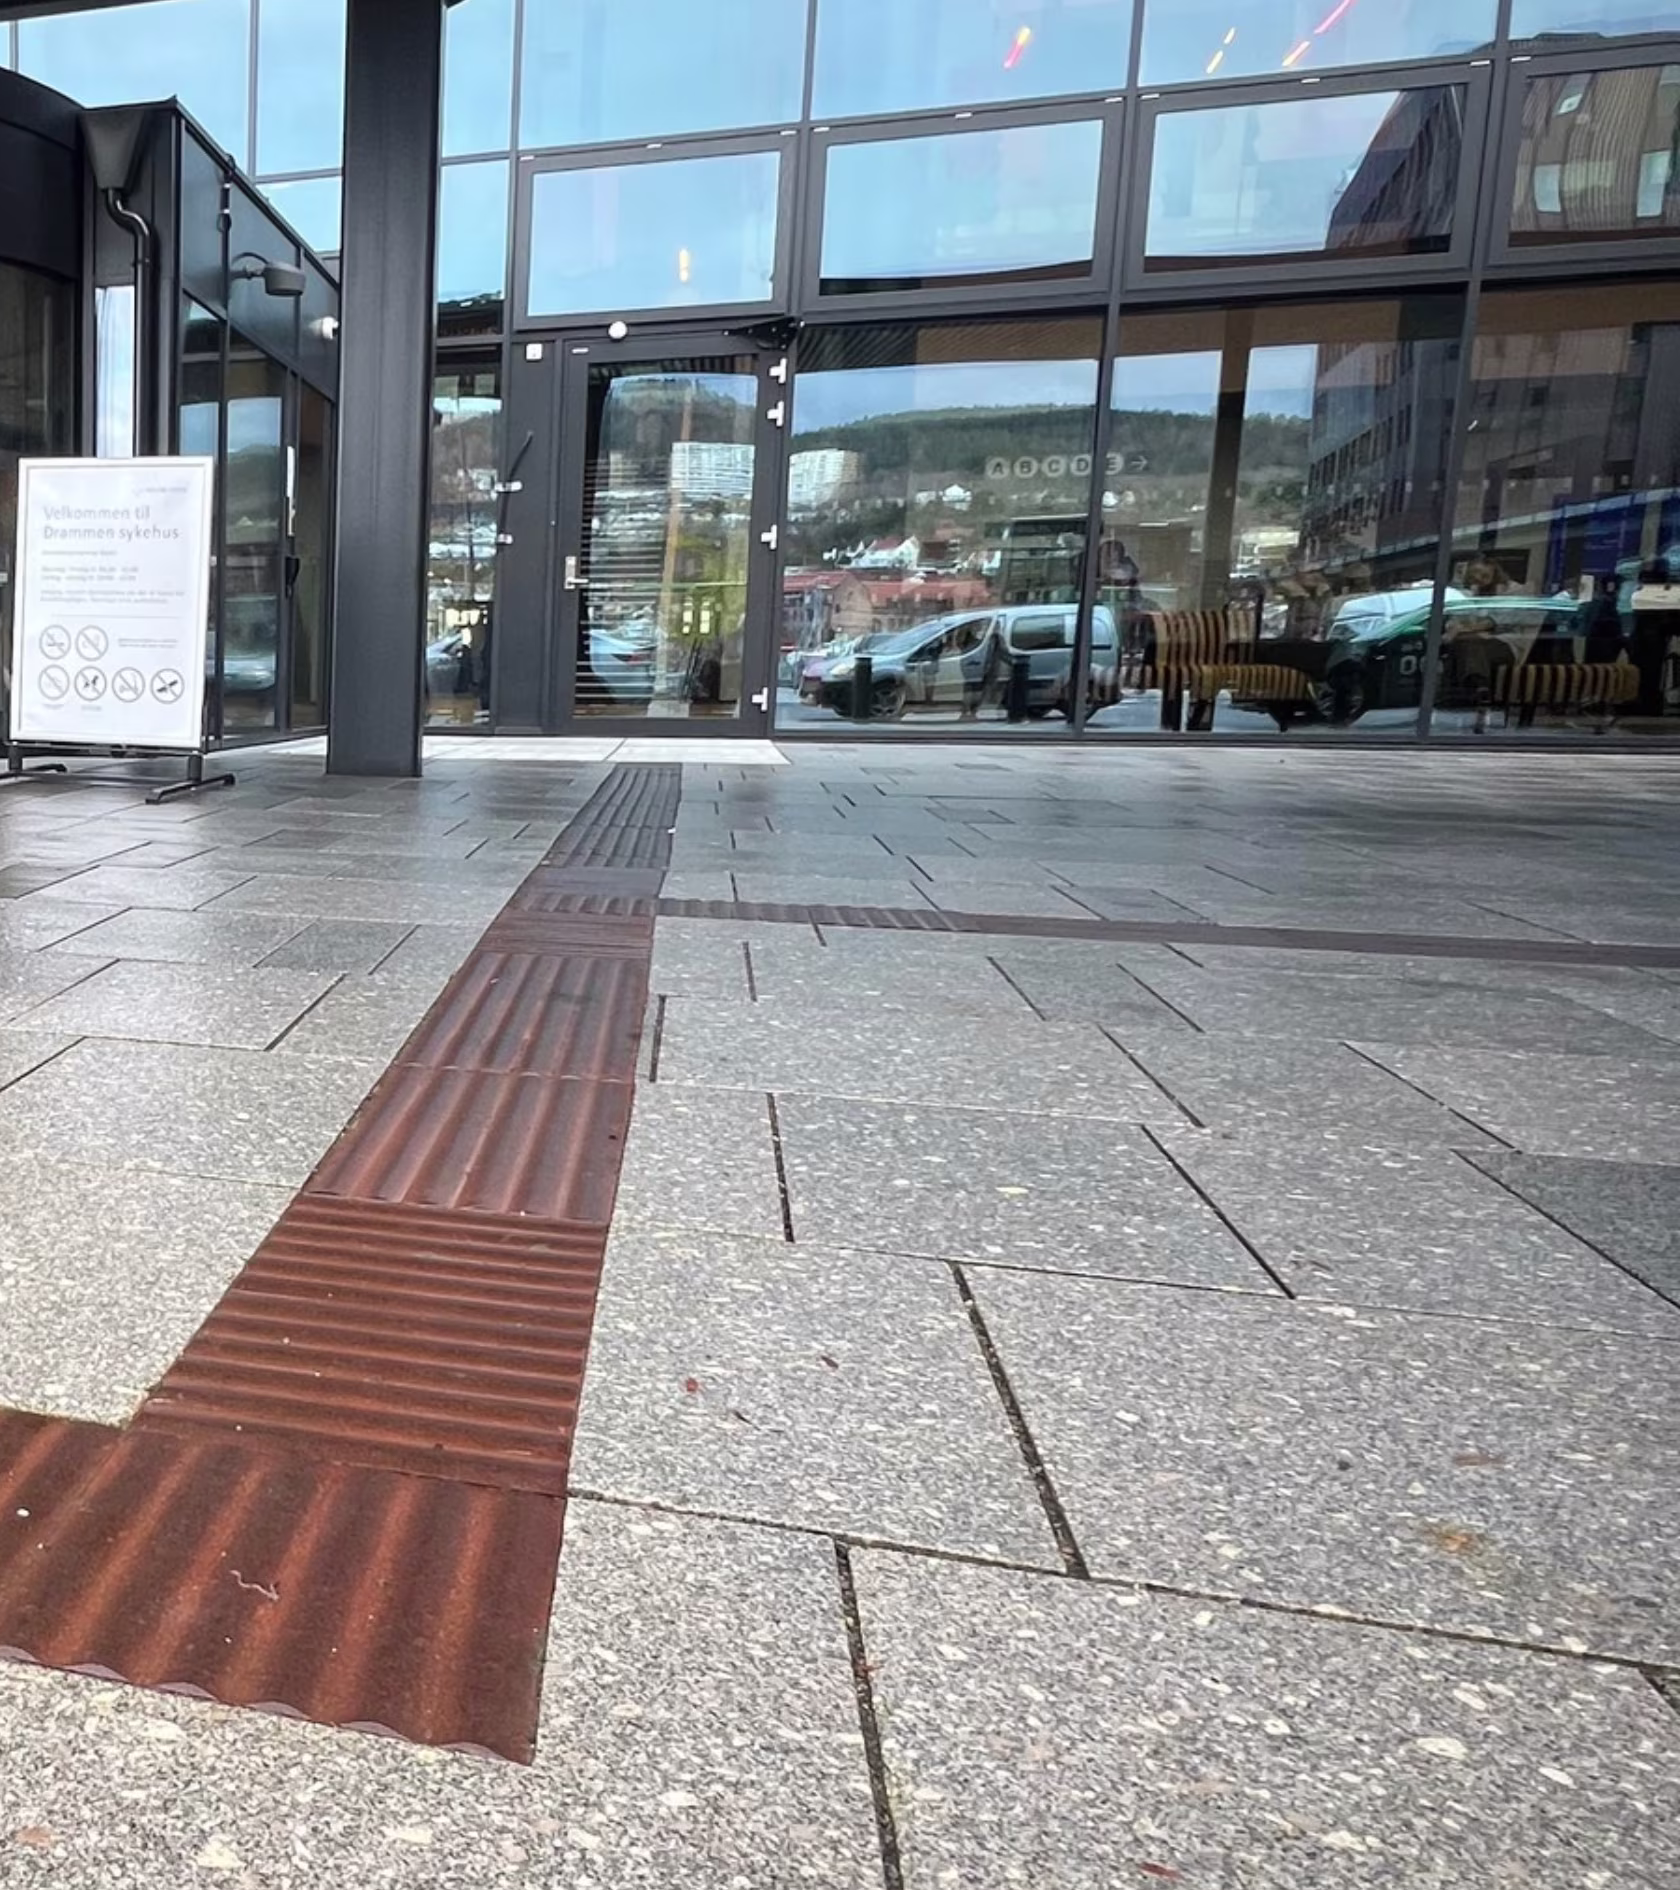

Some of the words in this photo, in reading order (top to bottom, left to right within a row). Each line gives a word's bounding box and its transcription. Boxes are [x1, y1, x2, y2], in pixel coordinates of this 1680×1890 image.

[43, 505, 130, 520] Velkommen
[135, 505, 150, 520] til
[43, 525, 115, 540] Drammen
[119, 524, 180, 543] sykehus
